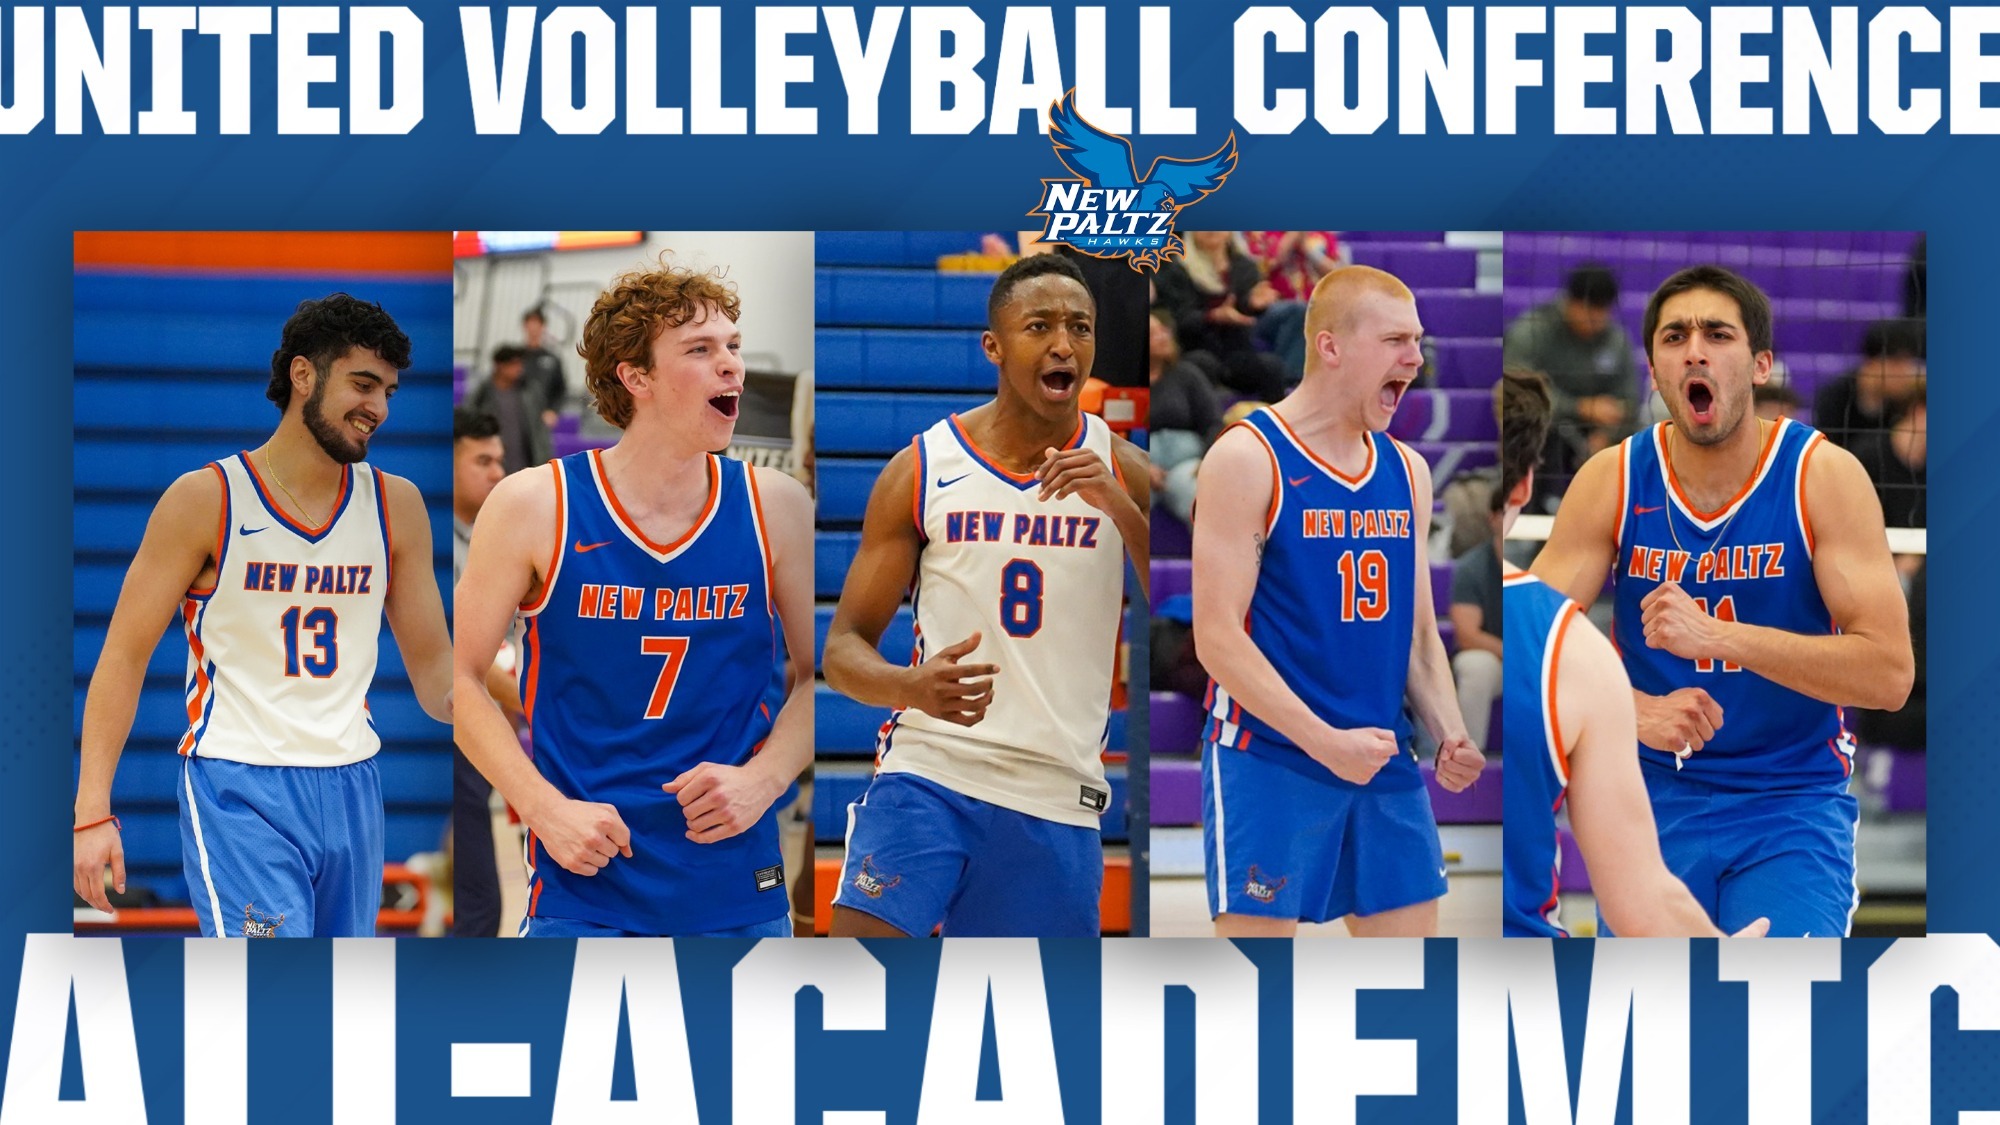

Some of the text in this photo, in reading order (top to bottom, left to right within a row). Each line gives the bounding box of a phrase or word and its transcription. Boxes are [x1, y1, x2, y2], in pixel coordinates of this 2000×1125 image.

[946, 511, 1101, 549] NEW PALTZ
[1303, 509, 1410, 538] NEW PALTZ
[243, 562, 372, 594] NEW PALTZ
[1628, 543, 1785, 583] NEW PALTZ
[578, 583, 749, 621] NEW PALTZ
[1000, 558, 1044, 638] 8
[1337, 550, 1389, 622] 19
[280, 605, 339, 678] 13
[640, 636, 690, 720] 7
